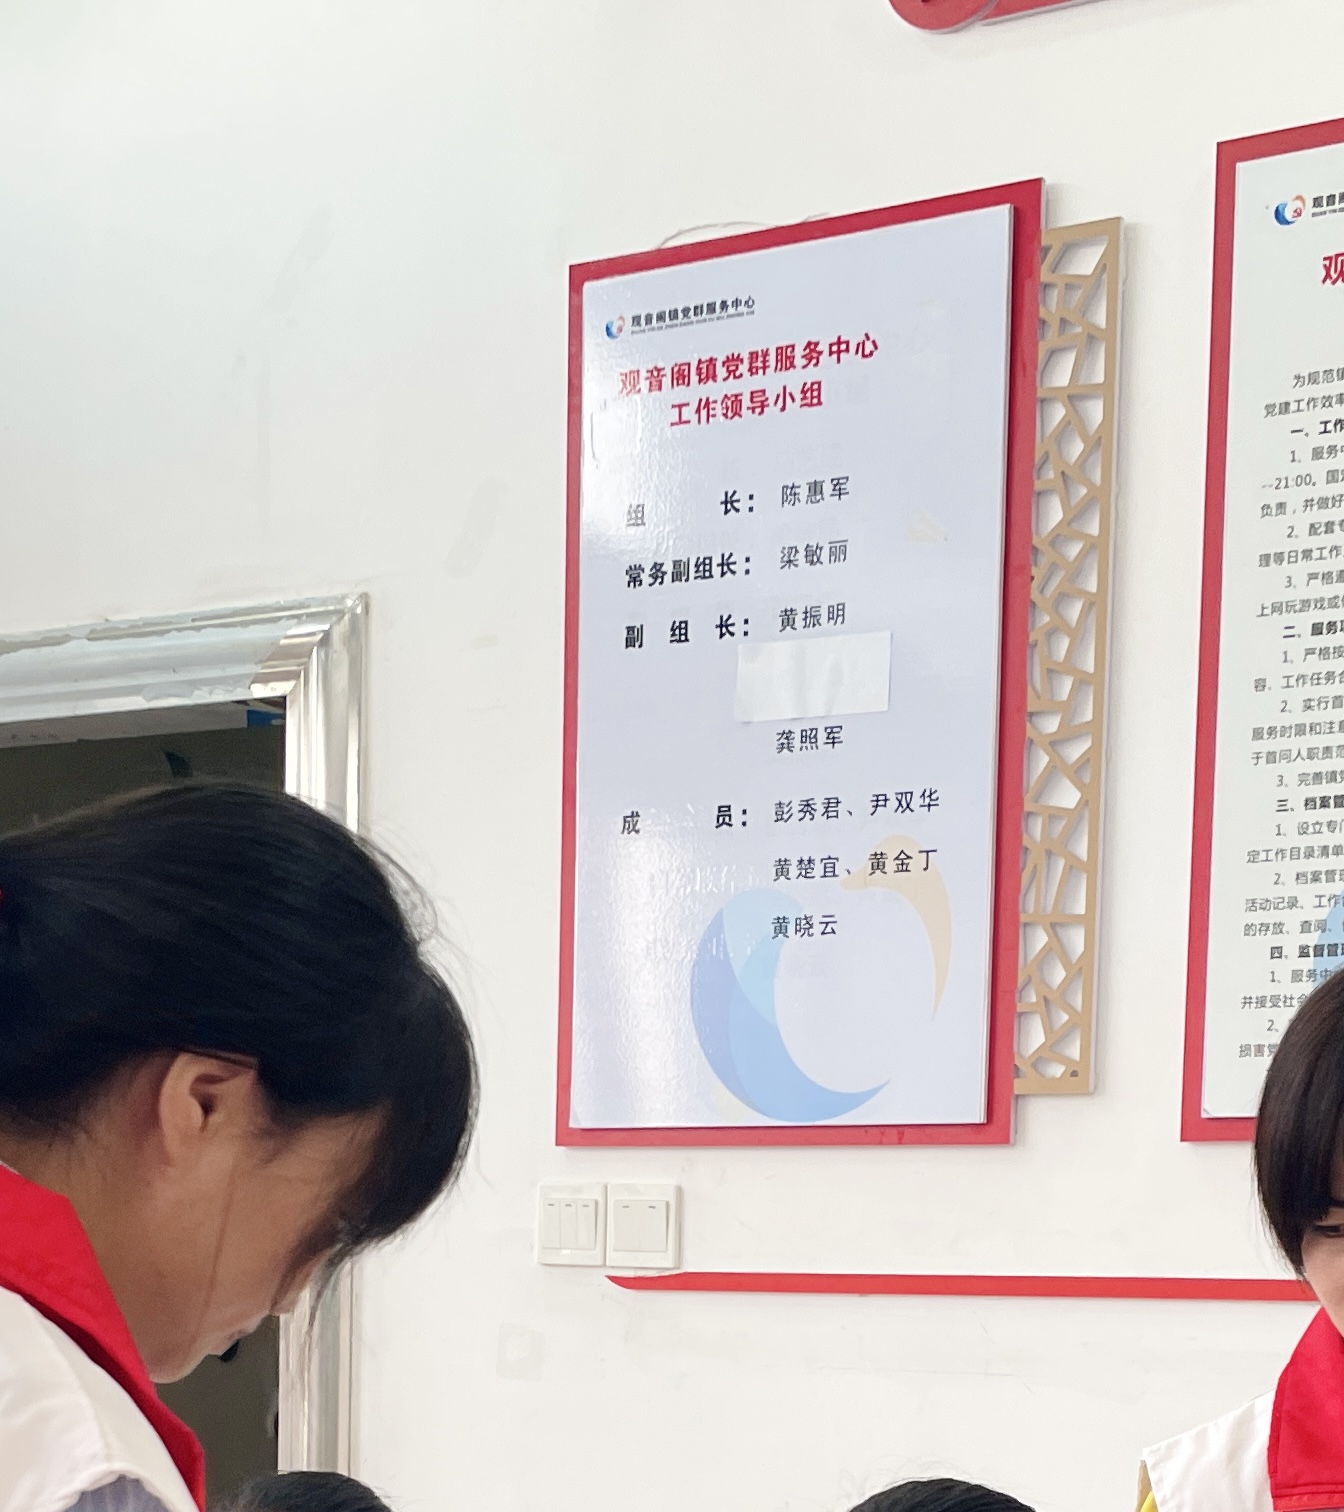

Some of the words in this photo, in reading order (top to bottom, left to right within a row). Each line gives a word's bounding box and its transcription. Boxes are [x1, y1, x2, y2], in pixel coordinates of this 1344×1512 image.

[619, 331, 878, 397] 观音阁镇党群服务中心
[669, 379, 823, 427] 工作领导小组
[625, 502, 646, 528] 组
[781, 475, 849, 508] 陈惠军
[624, 551, 750, 589] 常务副组长：
[779, 538, 848, 570] 梁敏丽
[778, 601, 845, 633] 黄振明
[775, 724, 843, 754] 龚照军
[619, 809, 641, 835] 成
[773, 787, 939, 823] 彭秀君、尹双华
[772, 848, 937, 882] 黄楚宜、黄金丁
[771, 913, 837, 940] 黄晓云
